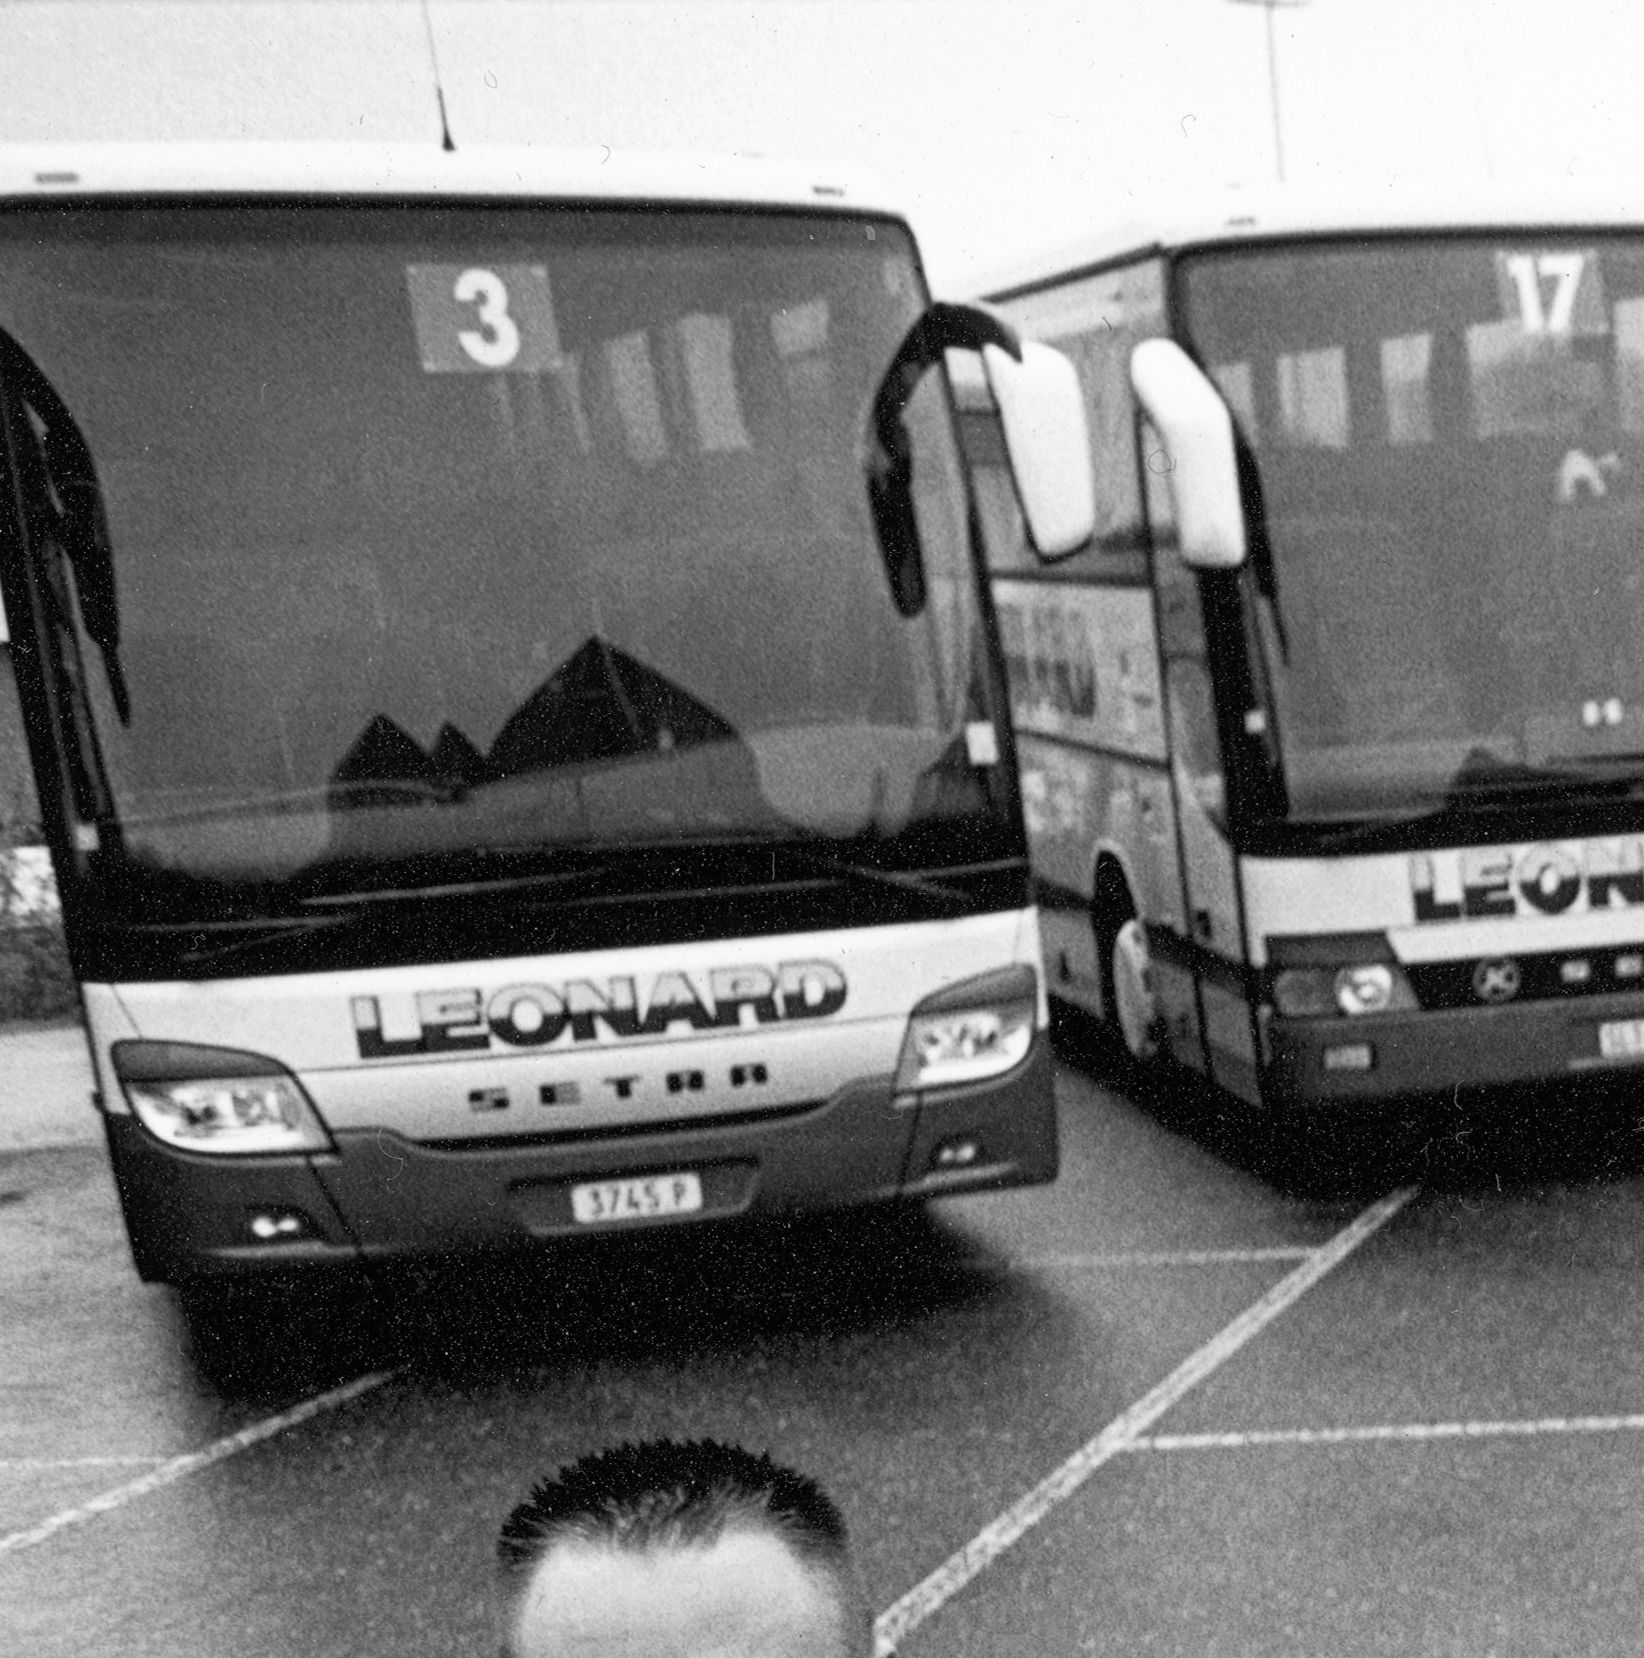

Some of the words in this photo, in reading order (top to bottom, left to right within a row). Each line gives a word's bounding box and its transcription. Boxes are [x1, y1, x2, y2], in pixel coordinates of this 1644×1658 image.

[453, 267, 520, 367] 3
[1506, 253, 1584, 333] 17
[351, 957, 848, 1059] LEONARD
[468, 1062, 769, 1113] SETRA
